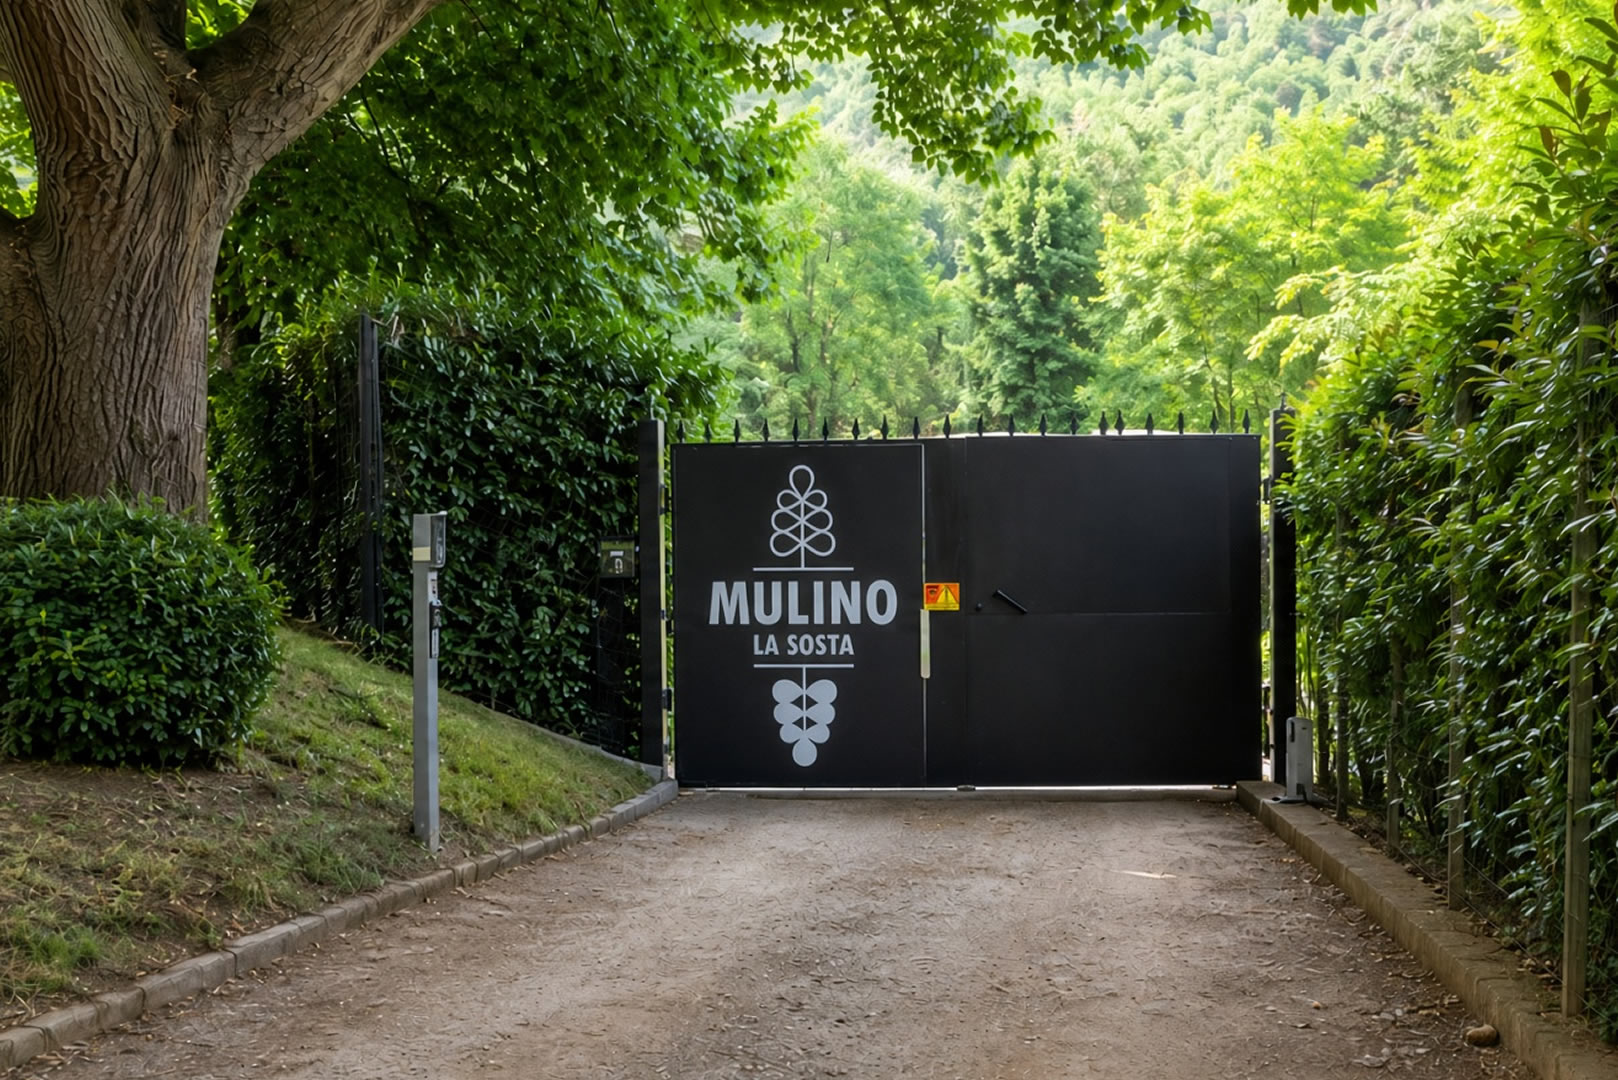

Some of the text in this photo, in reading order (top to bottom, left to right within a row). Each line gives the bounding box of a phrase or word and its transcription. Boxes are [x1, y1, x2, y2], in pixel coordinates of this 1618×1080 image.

[709, 580, 897, 625] MULINO
[754, 634, 854, 655] LA SOSTA
